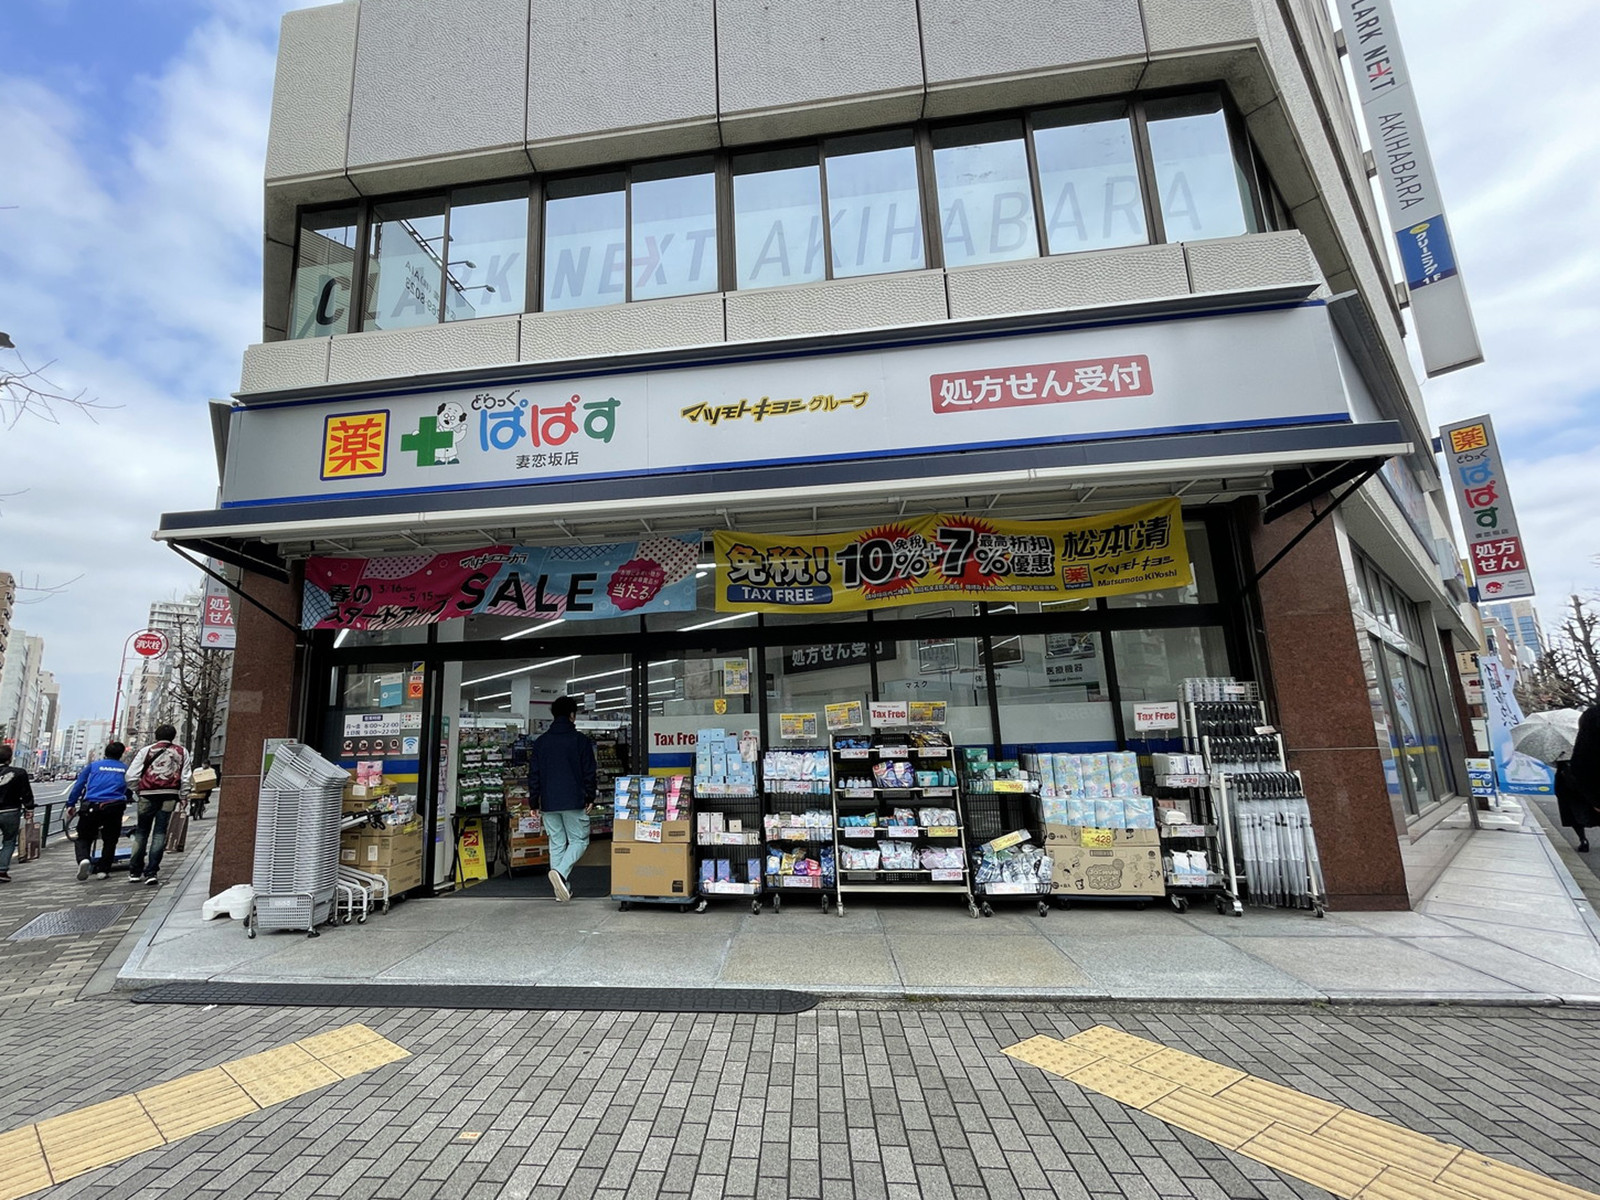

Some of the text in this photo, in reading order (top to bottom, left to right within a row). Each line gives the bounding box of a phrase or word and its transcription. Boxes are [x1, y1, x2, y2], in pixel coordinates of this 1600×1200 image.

[1363, 45, 1396, 91] NEXT
[1378, 112, 1425, 211] AKIHABARA
[551, 229, 717, 299] NEXT
[749, 171, 1203, 281] AKIHABARA
[940, 361, 1143, 408] 処方せん受付
[471, 390, 521, 411] どらっぐ
[480, 394, 621, 453] ぱぱす
[328, 420, 382, 474] 薬
[1454, 427, 1485, 451] 薬
[516, 451, 580, 470] 妻恋坂店
[1459, 457, 1499, 529] ぱぱす
[978, 533, 1010, 549] 最高
[1009, 534, 1053, 556] 折扣
[1062, 515, 1172, 562] 松本清
[1475, 541, 1516, 559] 処方
[1012, 555, 1054, 575] 優惠
[1064, 565, 1090, 583] 薬
[1093, 556, 1175, 575] マツモトキヨシ
[1479, 557, 1520, 572] せん
[612, 582, 657, 600] 当たる!
[1098, 575, 1144, 587] Matsumoto
[330, 583, 374, 605] 春の
[456, 571, 598, 613] SALE
[742, 586, 815, 602] TAX FREE
[324, 597, 452, 625] スタートアップ
[136, 639, 162, 650] 消火栓
[905, 680, 928, 689] マスク
[872, 709, 906, 719] Tax Free
[1137, 711, 1177, 721] Tax Free
[654, 733, 674, 746] Tax
